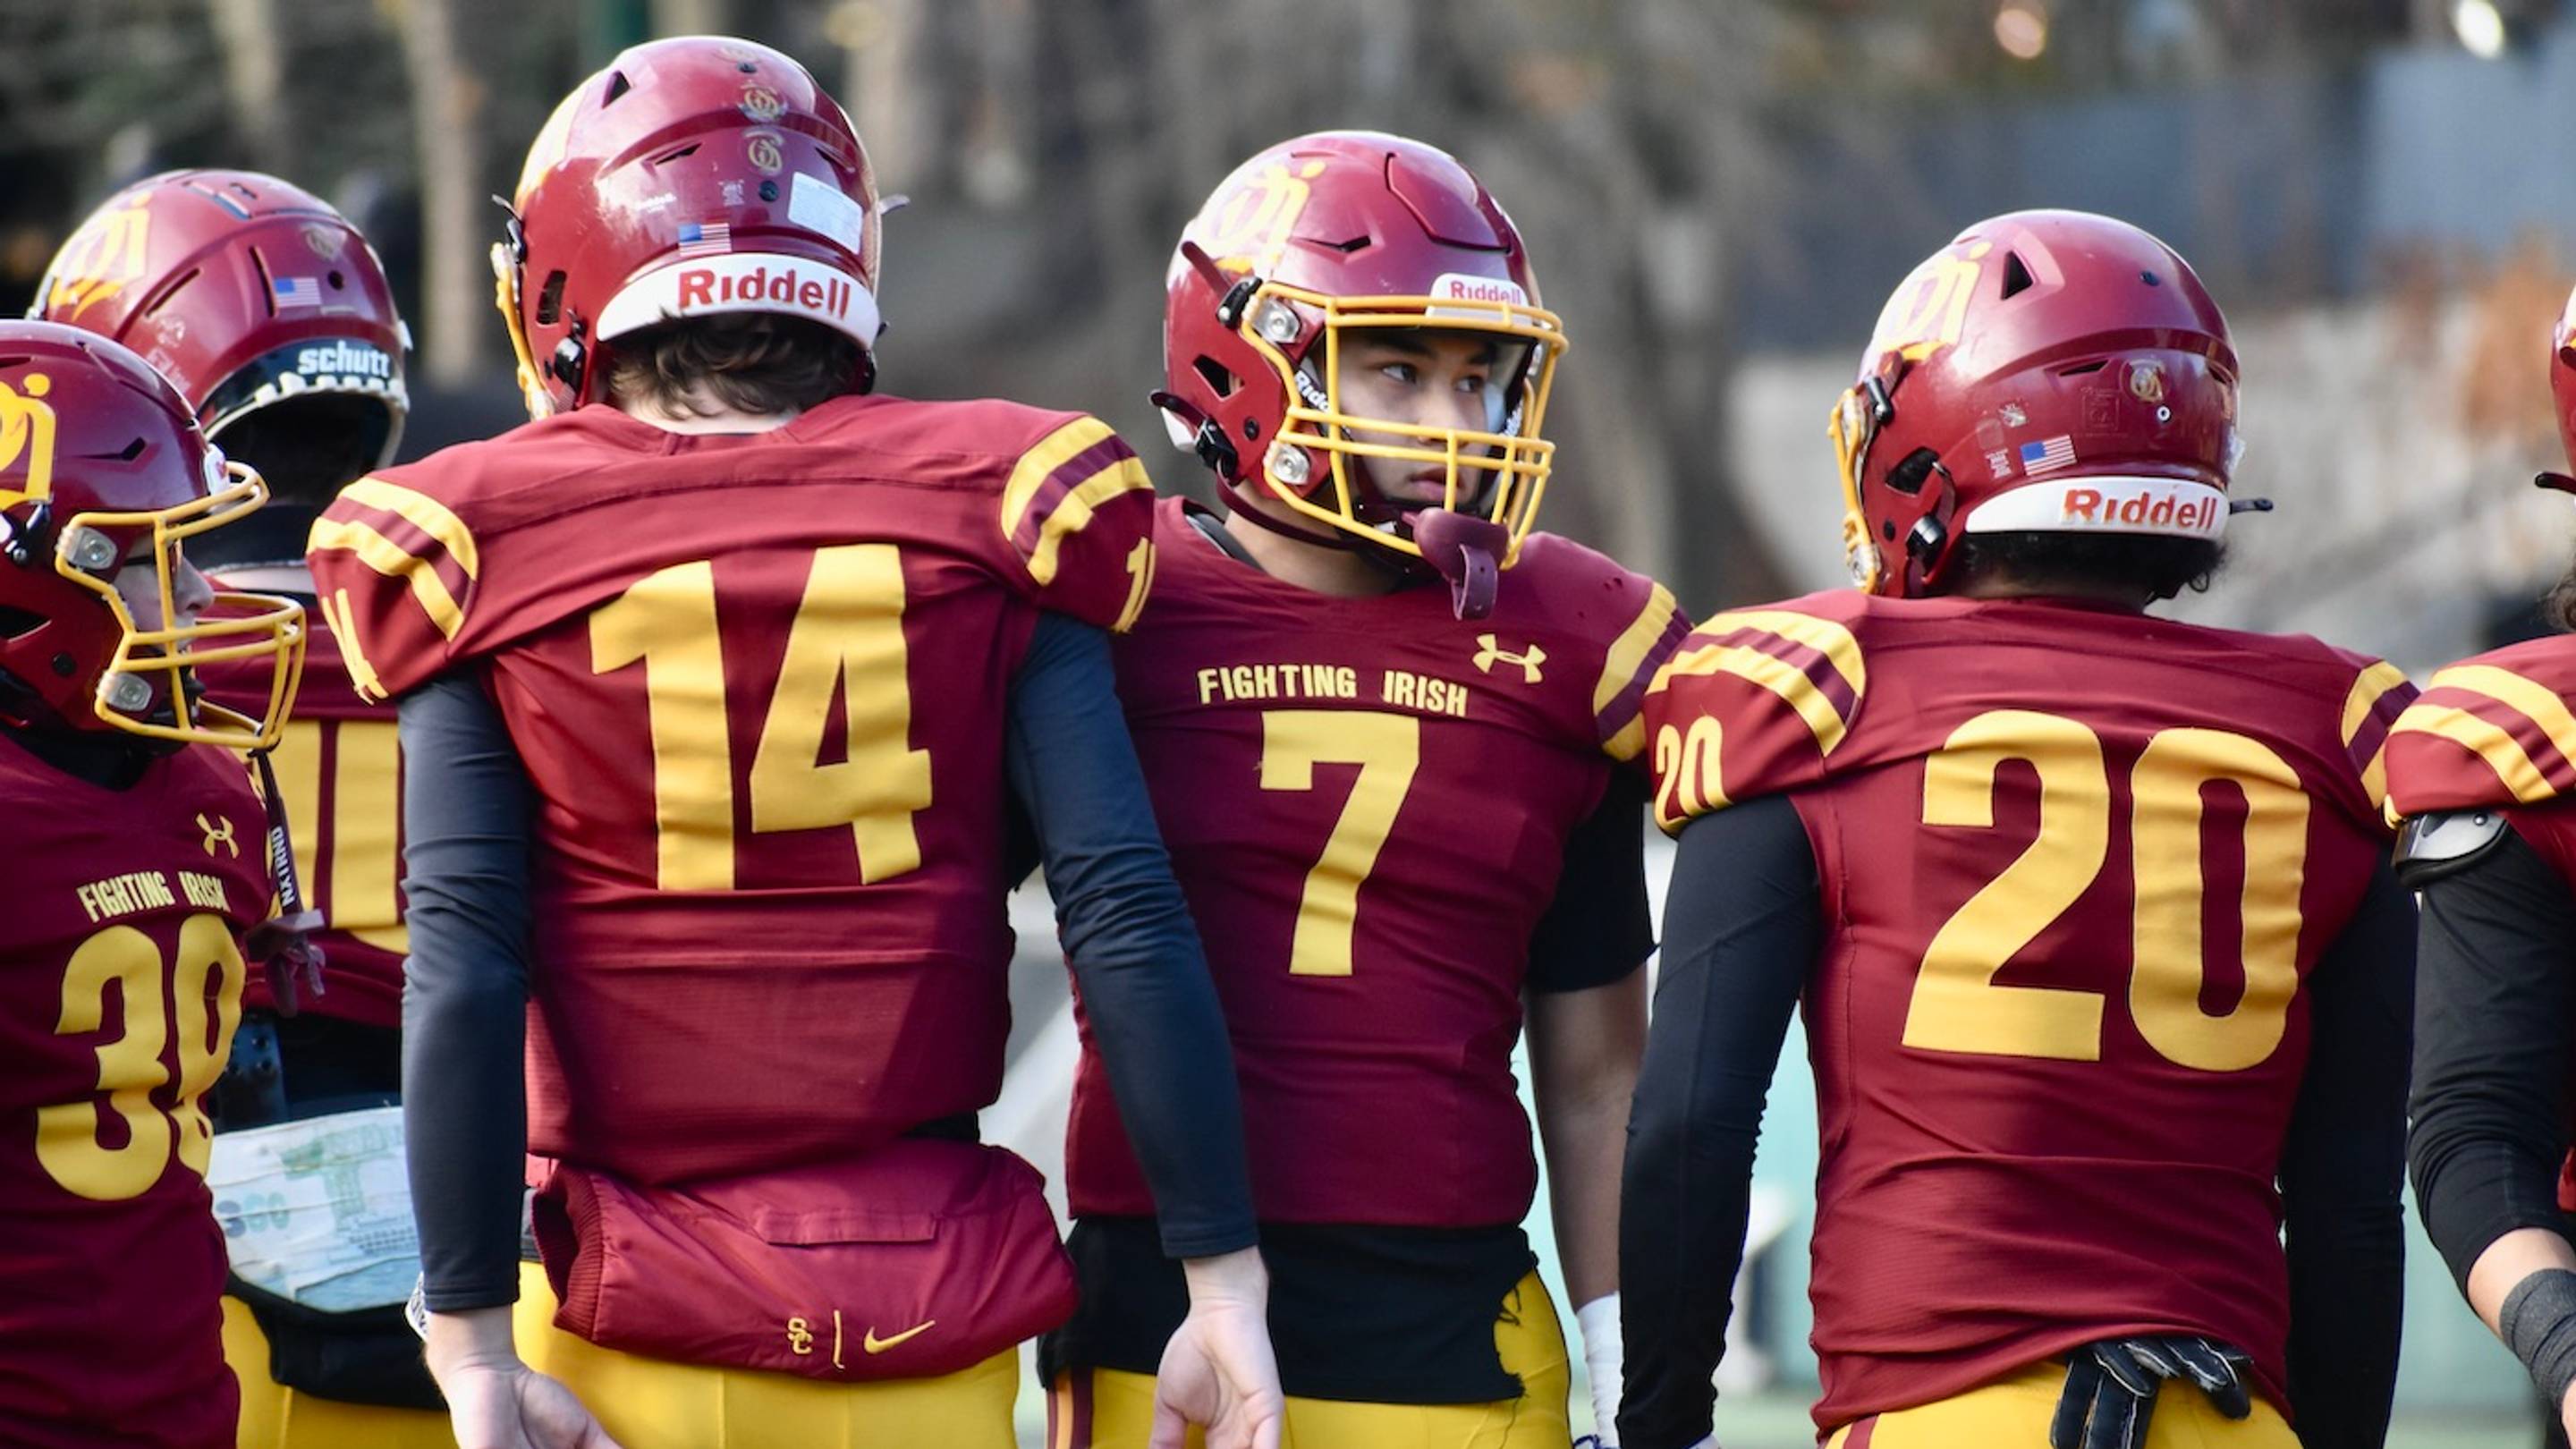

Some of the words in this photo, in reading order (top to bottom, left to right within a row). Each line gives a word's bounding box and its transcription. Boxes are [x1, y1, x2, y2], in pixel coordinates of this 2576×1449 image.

[679, 267, 851, 320] Riddell
[1450, 280, 1522, 306] Riddell
[297, 340, 390, 378] schutt
[2063, 488, 2217, 530] Riddell
[1198, 665, 1357, 704] FIGHTING
[1383, 670, 1468, 716] IRISH
[589, 544, 932, 892] 14
[1655, 715, 1733, 839] 20
[1259, 709, 1419, 977] 7
[76, 871, 175, 923] FIGHTING
[1902, 709, 2310, 1072] 20
[35, 913, 247, 1201] 38
